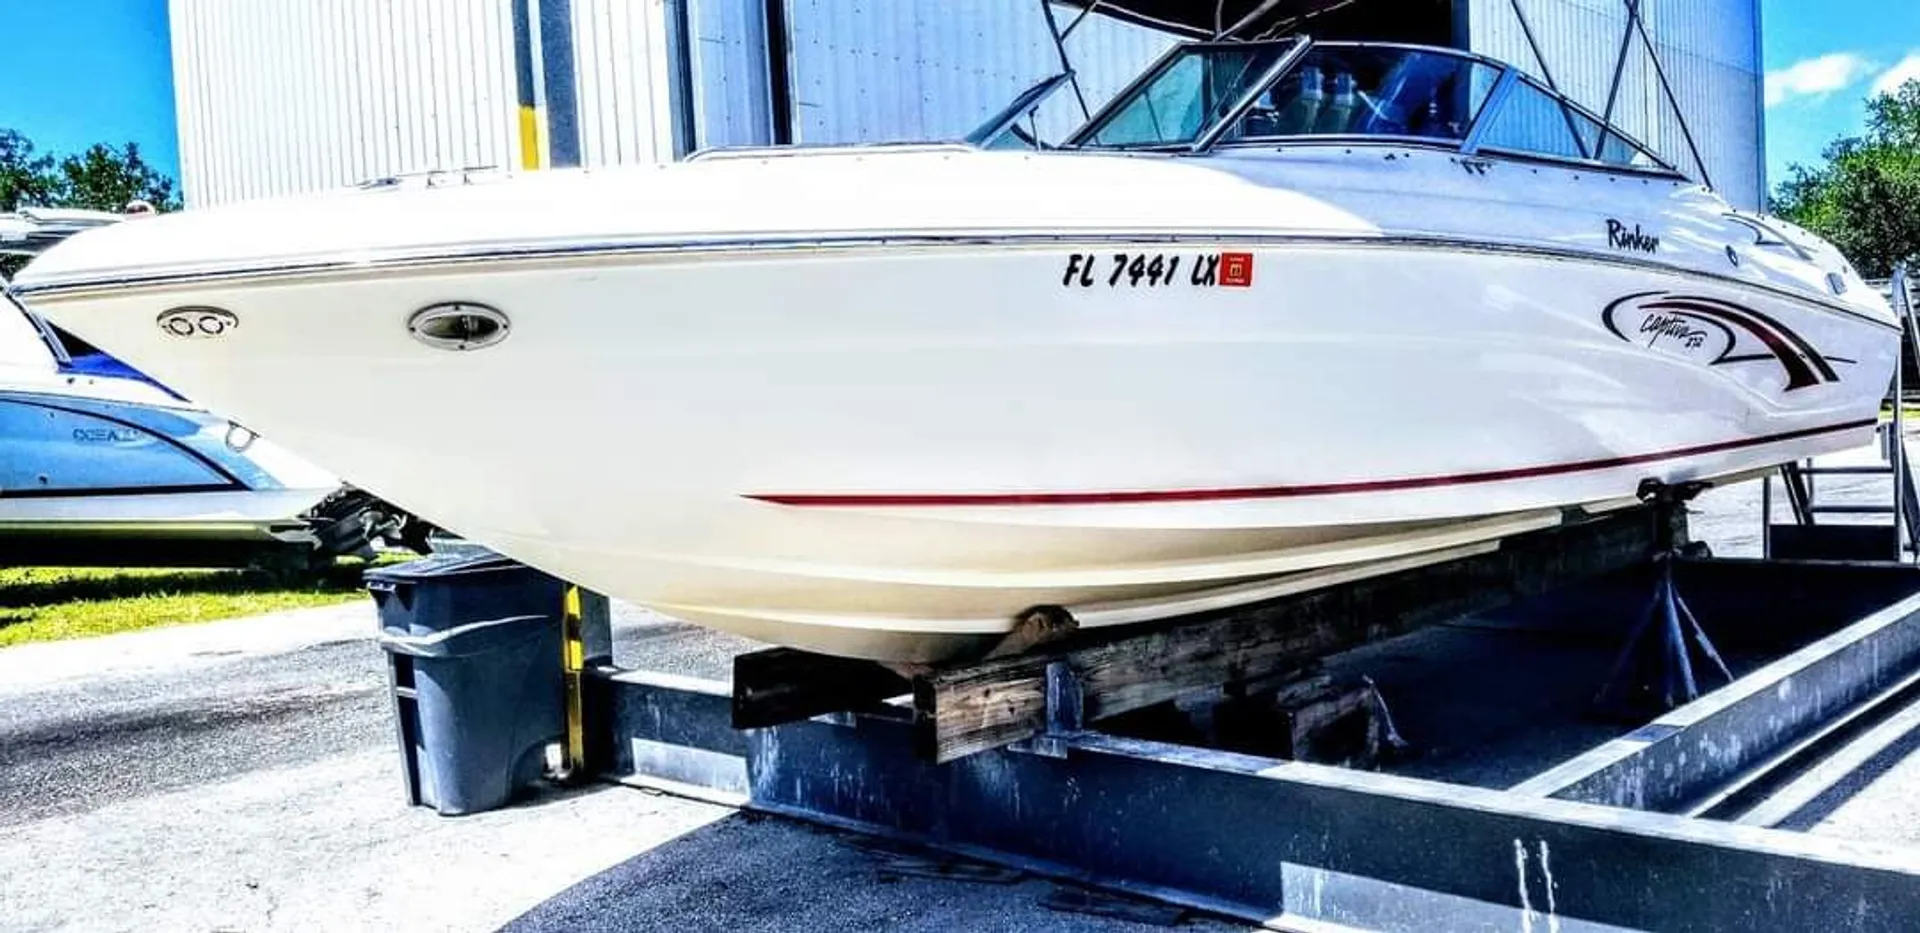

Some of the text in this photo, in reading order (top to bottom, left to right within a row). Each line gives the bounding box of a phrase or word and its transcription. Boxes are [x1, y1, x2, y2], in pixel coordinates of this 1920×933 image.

[1606, 218, 1660, 254] Rinker
[1063, 253, 1095, 287] FL
[1109, 253, 1180, 287] 7441
[1191, 253, 1220, 286] LX
